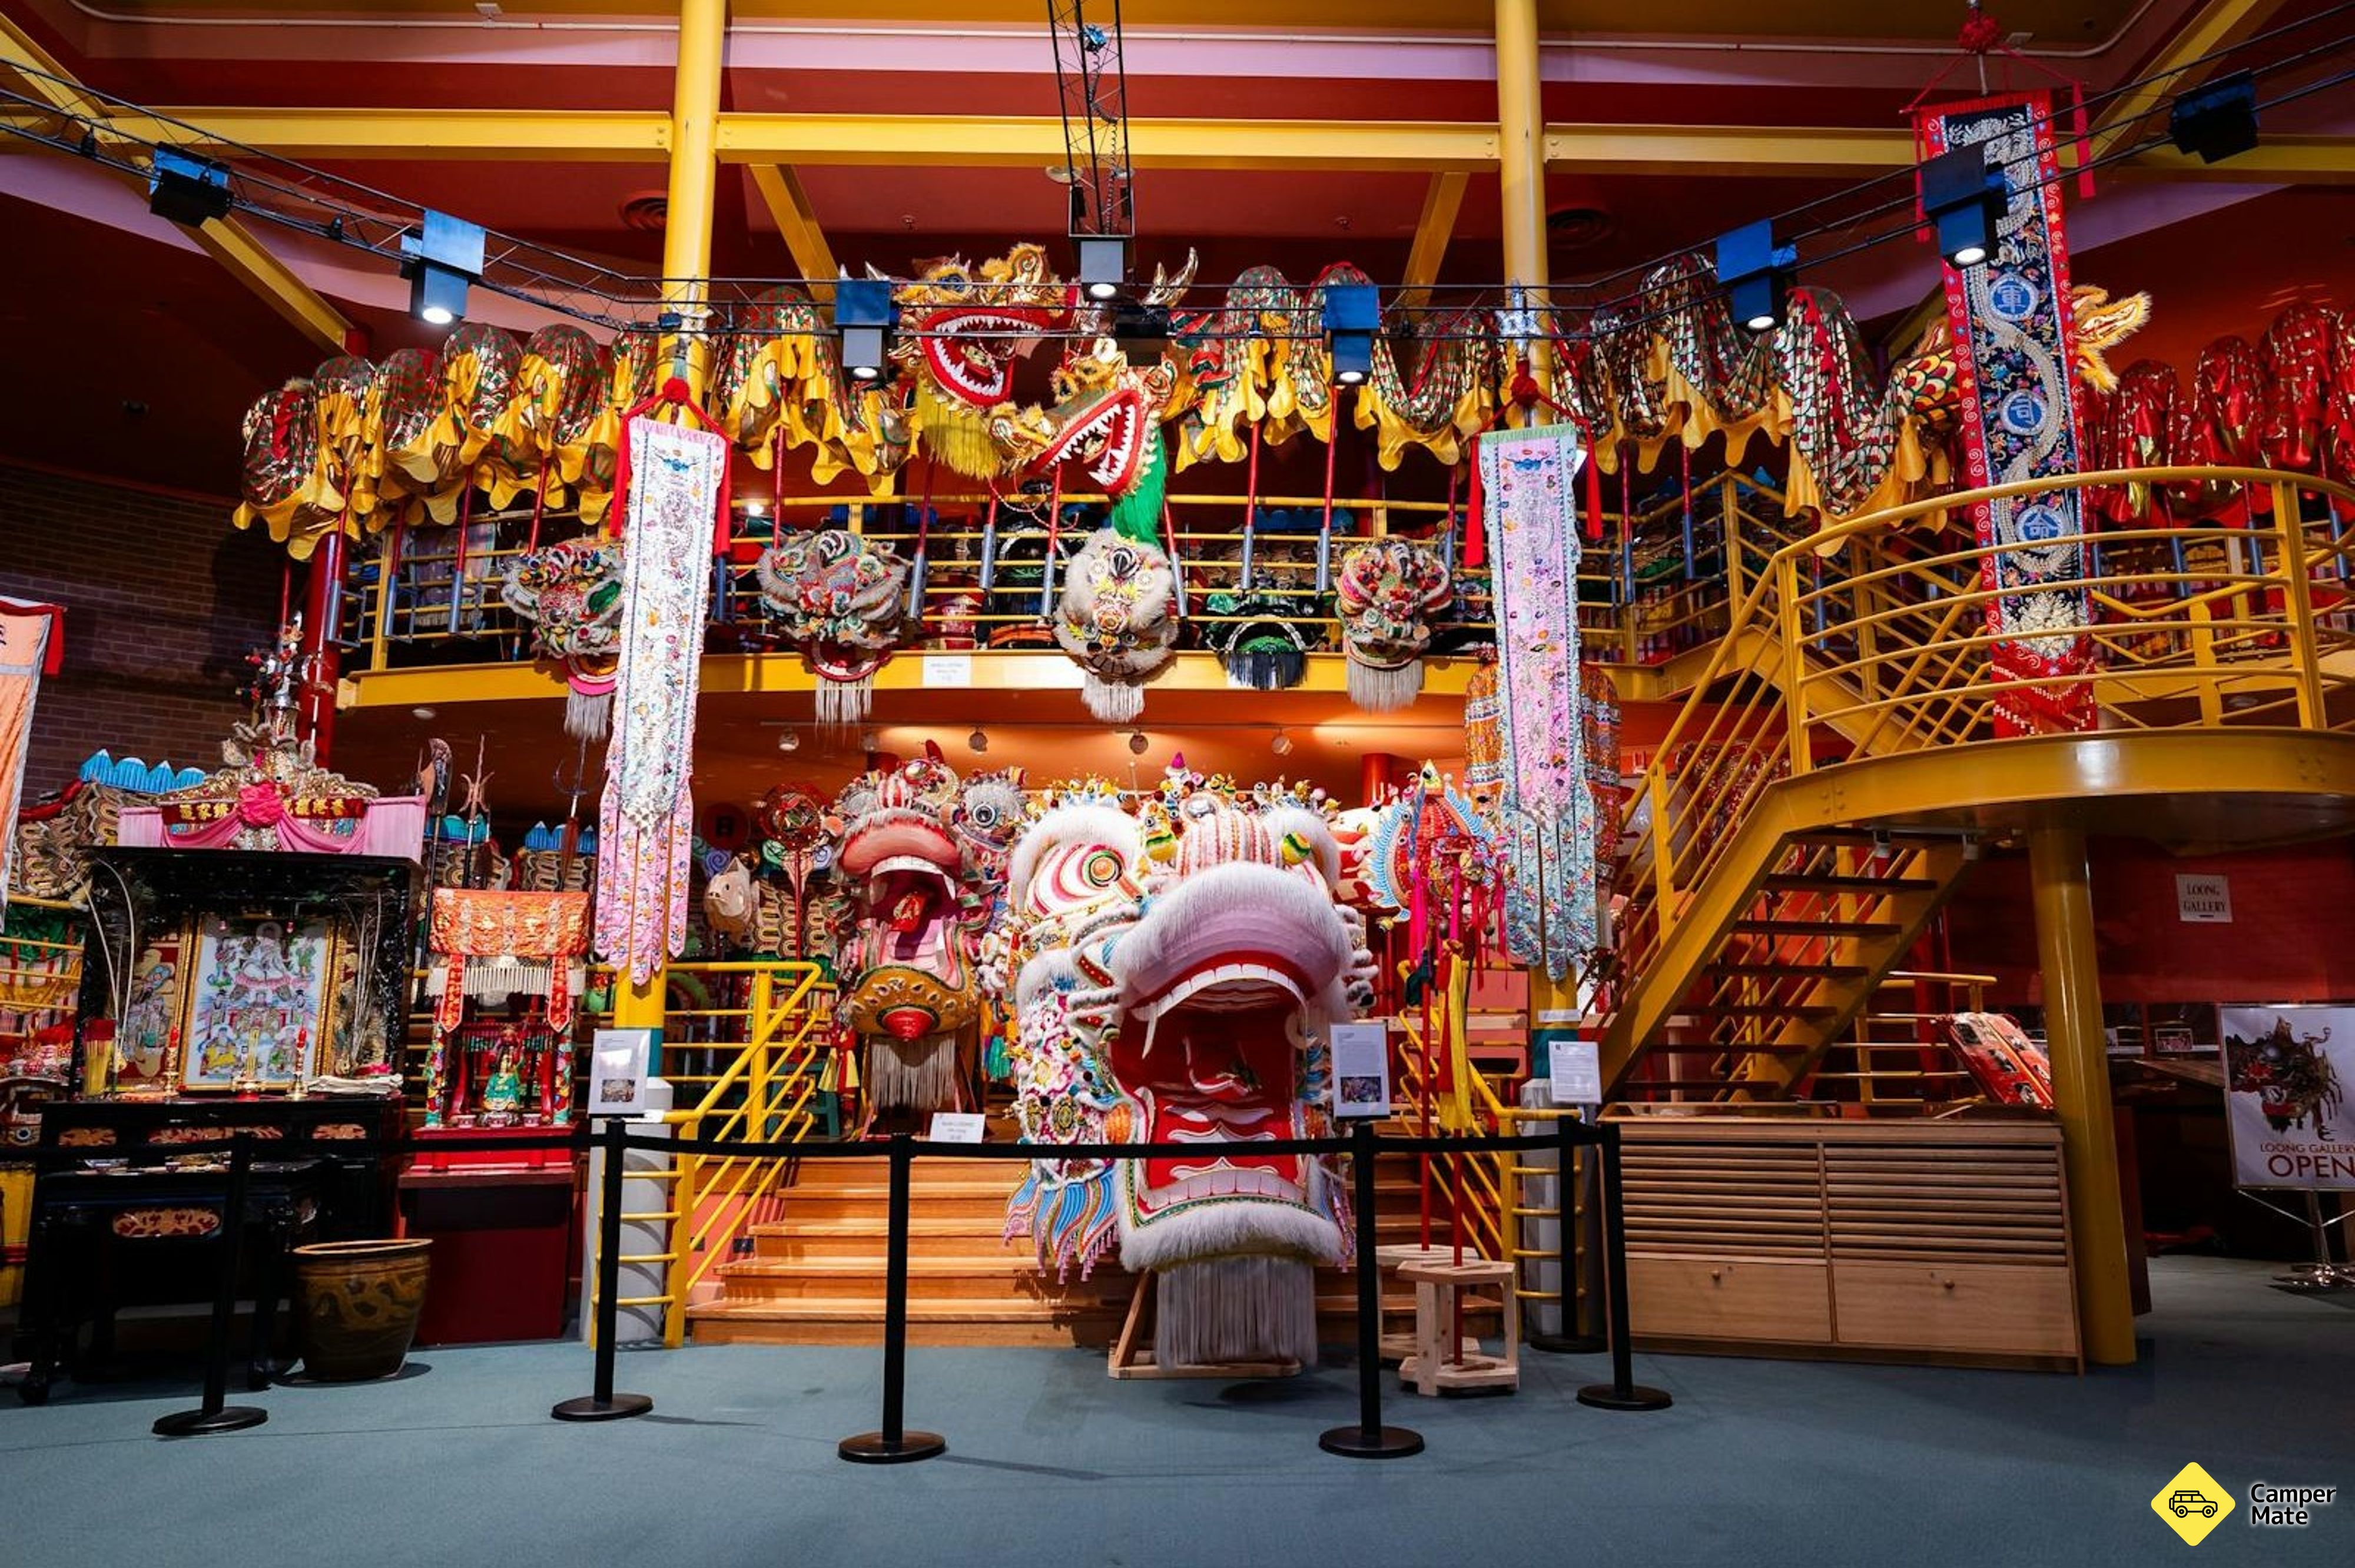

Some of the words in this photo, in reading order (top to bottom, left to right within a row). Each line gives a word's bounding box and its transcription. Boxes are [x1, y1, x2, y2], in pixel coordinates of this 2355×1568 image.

[1997, 285, 2026, 314] 軍
[2010, 398, 2035, 426] 司
[2187, 884, 2220, 895] LOONG
[2184, 901, 2225, 912] GALLERY
[2261, 1144, 2306, 1152] LOONG
[2268, 1155, 2355, 1178] OPEN
